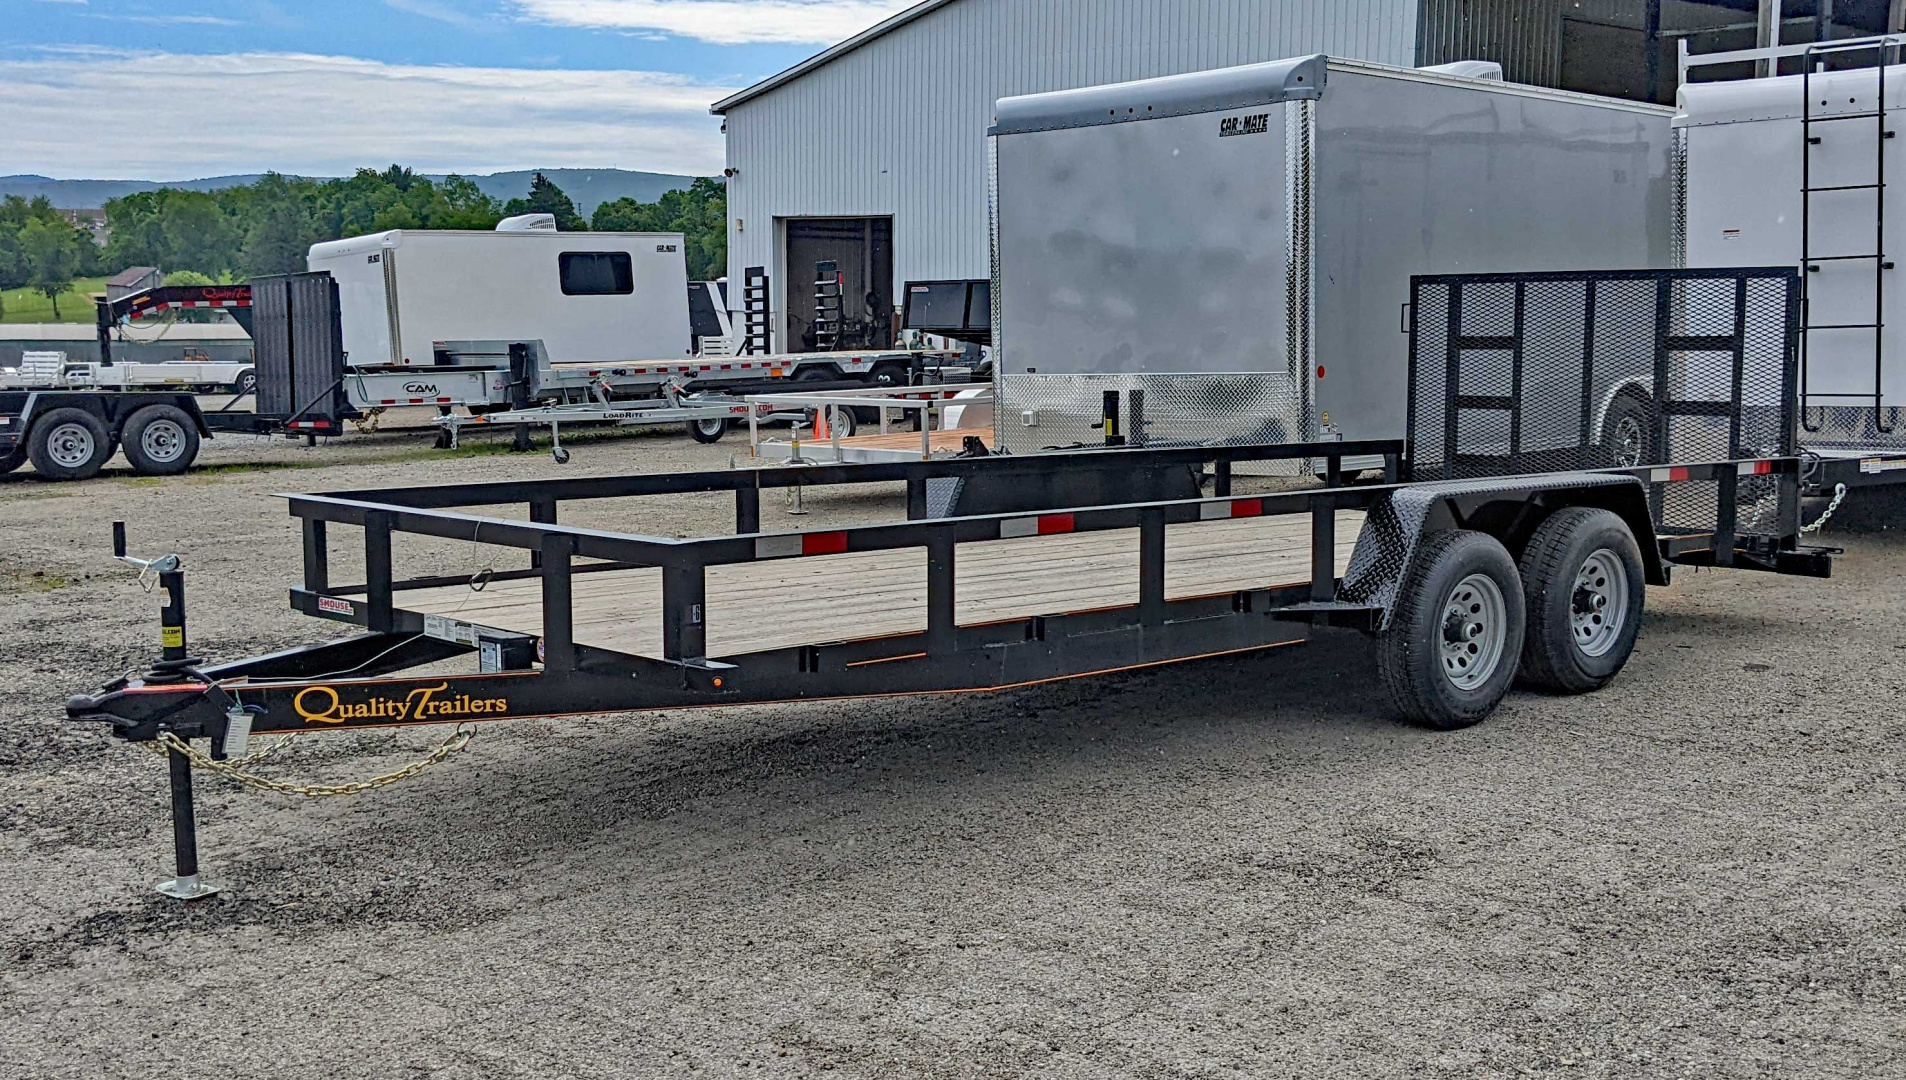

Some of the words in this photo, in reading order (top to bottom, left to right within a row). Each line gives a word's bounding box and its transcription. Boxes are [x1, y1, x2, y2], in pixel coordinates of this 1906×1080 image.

[406, 384, 437, 393] CAM
[320, 598, 350, 611] SMOUSE
[294, 686, 411, 723] Quality
[406, 681, 508, 720] Trailers
